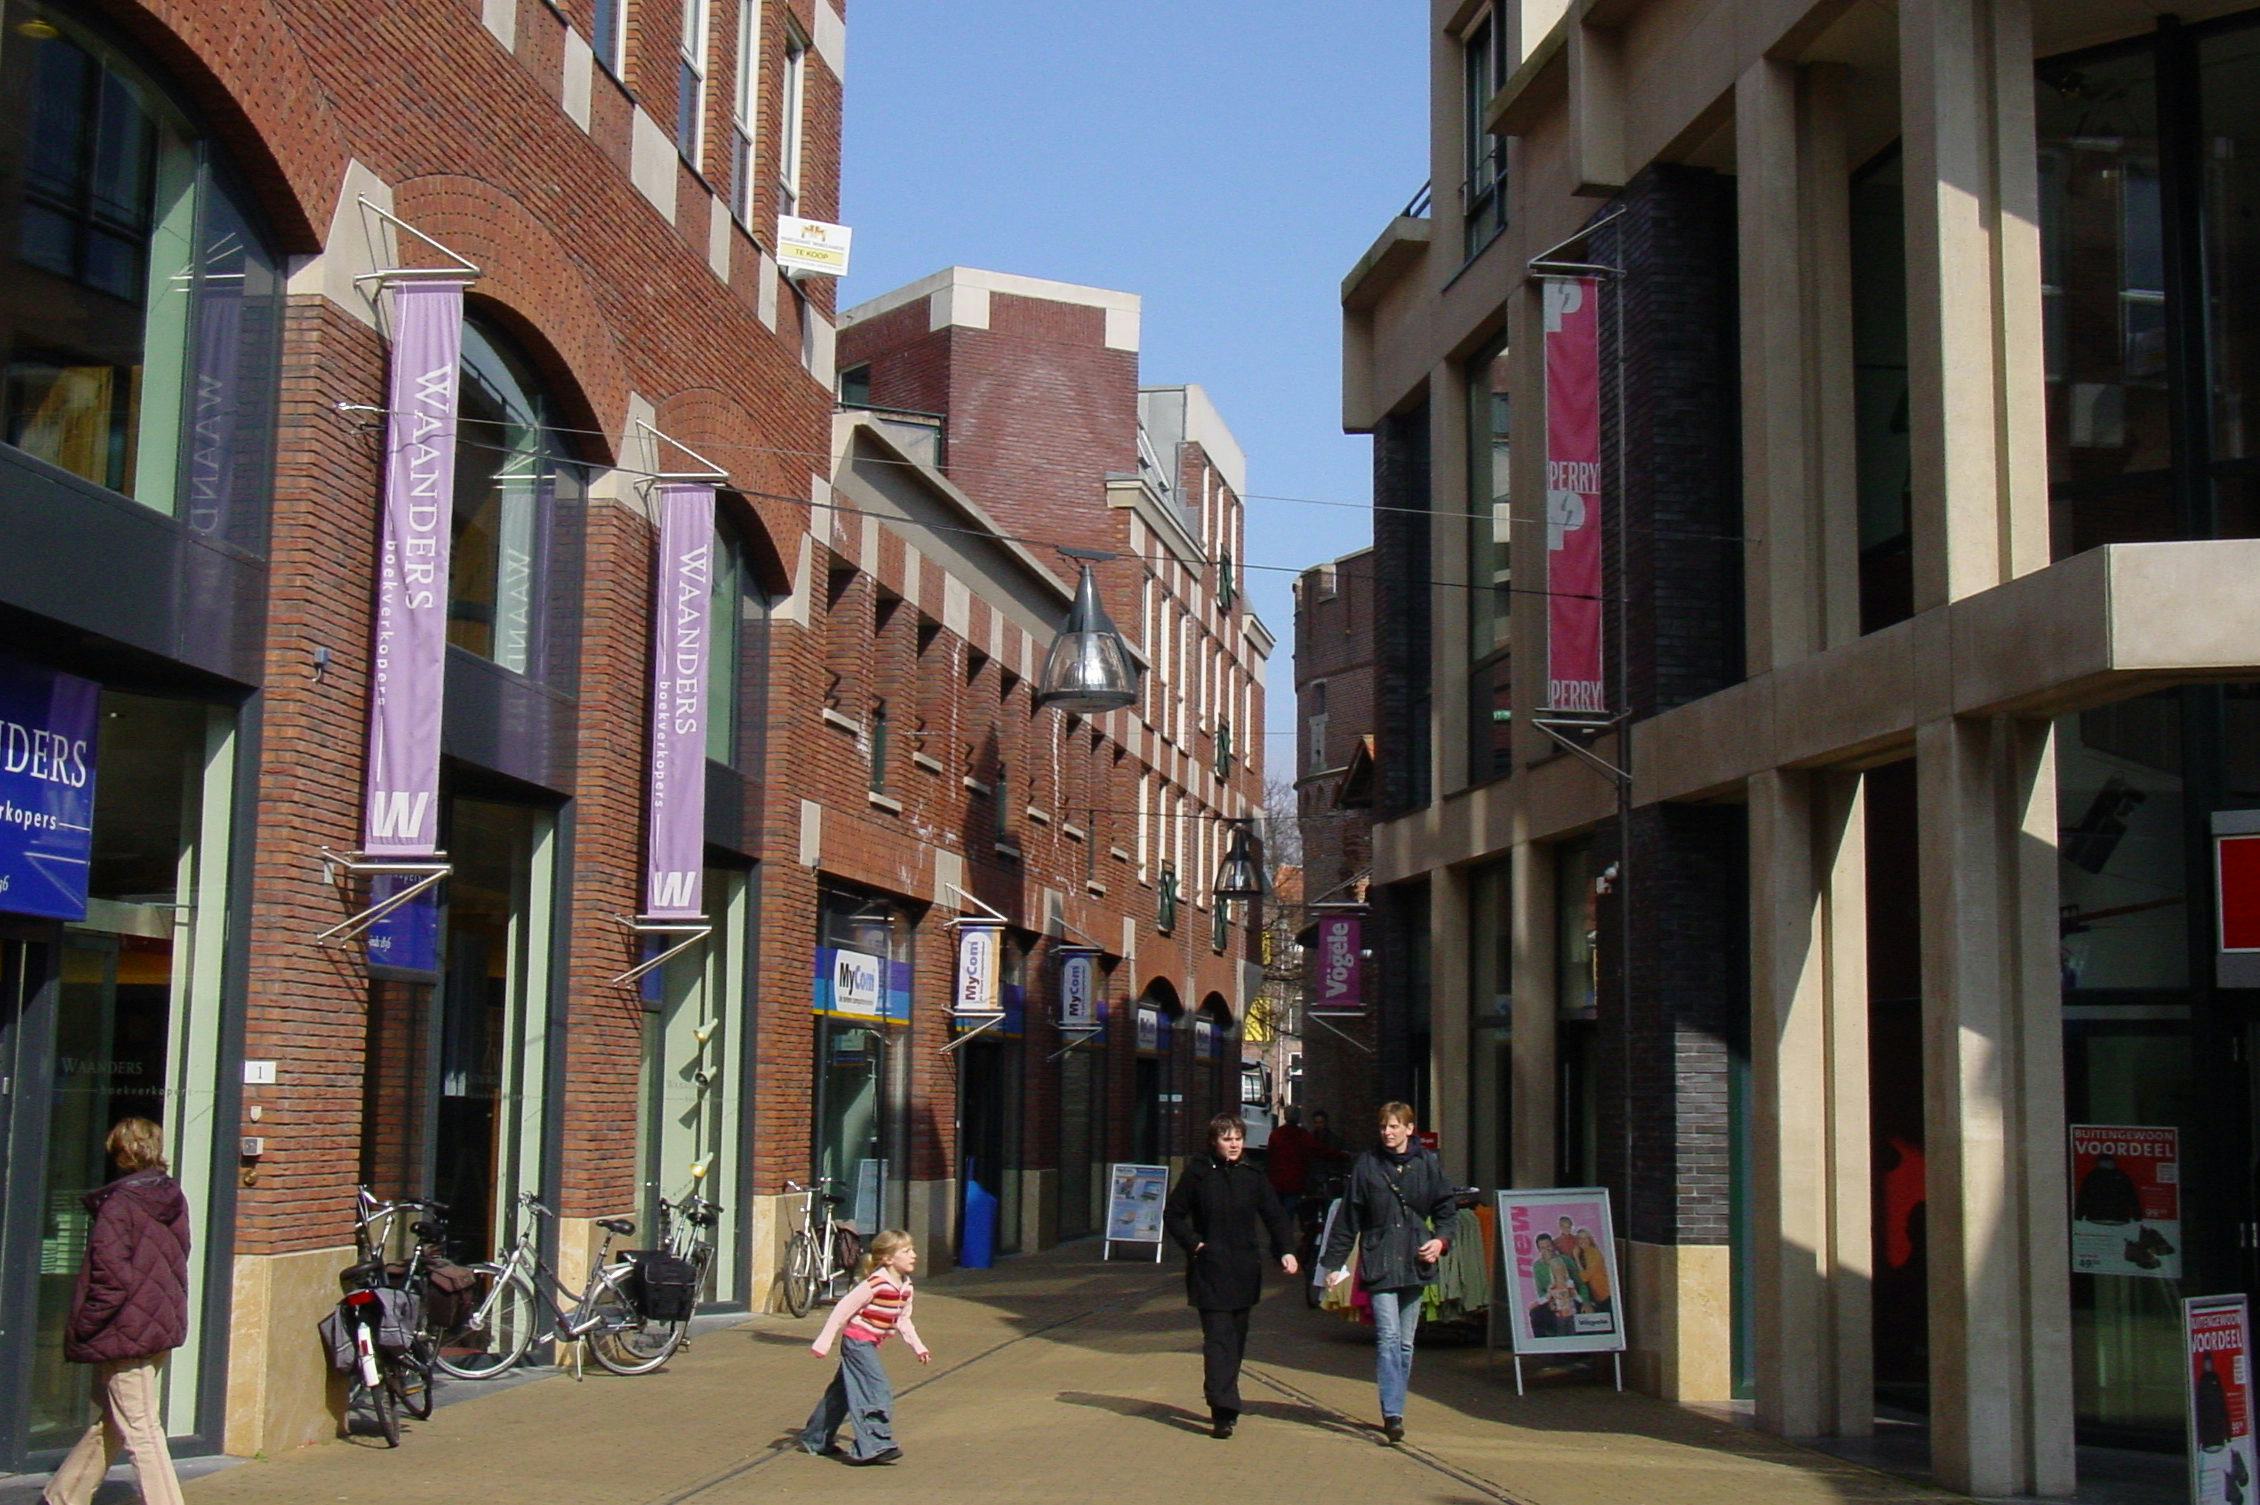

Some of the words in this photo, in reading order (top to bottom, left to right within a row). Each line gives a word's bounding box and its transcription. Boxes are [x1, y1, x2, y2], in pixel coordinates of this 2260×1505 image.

[404, 362, 452, 610] WAANDERS
[1549, 461, 1600, 491] PERRY
[377, 540, 397, 706] boekverkopers
[674, 544, 708, 735] WAANDERS
[1550, 680, 1601, 710] PERRY
[0, 720, 87, 788] DERS
[655, 681, 671, 808] boekverkopers
[371, 791, 430, 838] W
[653, 871, 697, 908] W
[839, 962, 875, 996] MyCom
[965, 941, 979, 1001] MyCom
[1326, 923, 1354, 999] Vögele
[1069, 965, 1081, 1017] MyCom
[2074, 1129, 2173, 1141] BUITENGEWOON
[2075, 1141, 2174, 1157] VOORDEEL
[1510, 1205, 1533, 1279] new
[2191, 1328, 2242, 1352] VOORDEEL
